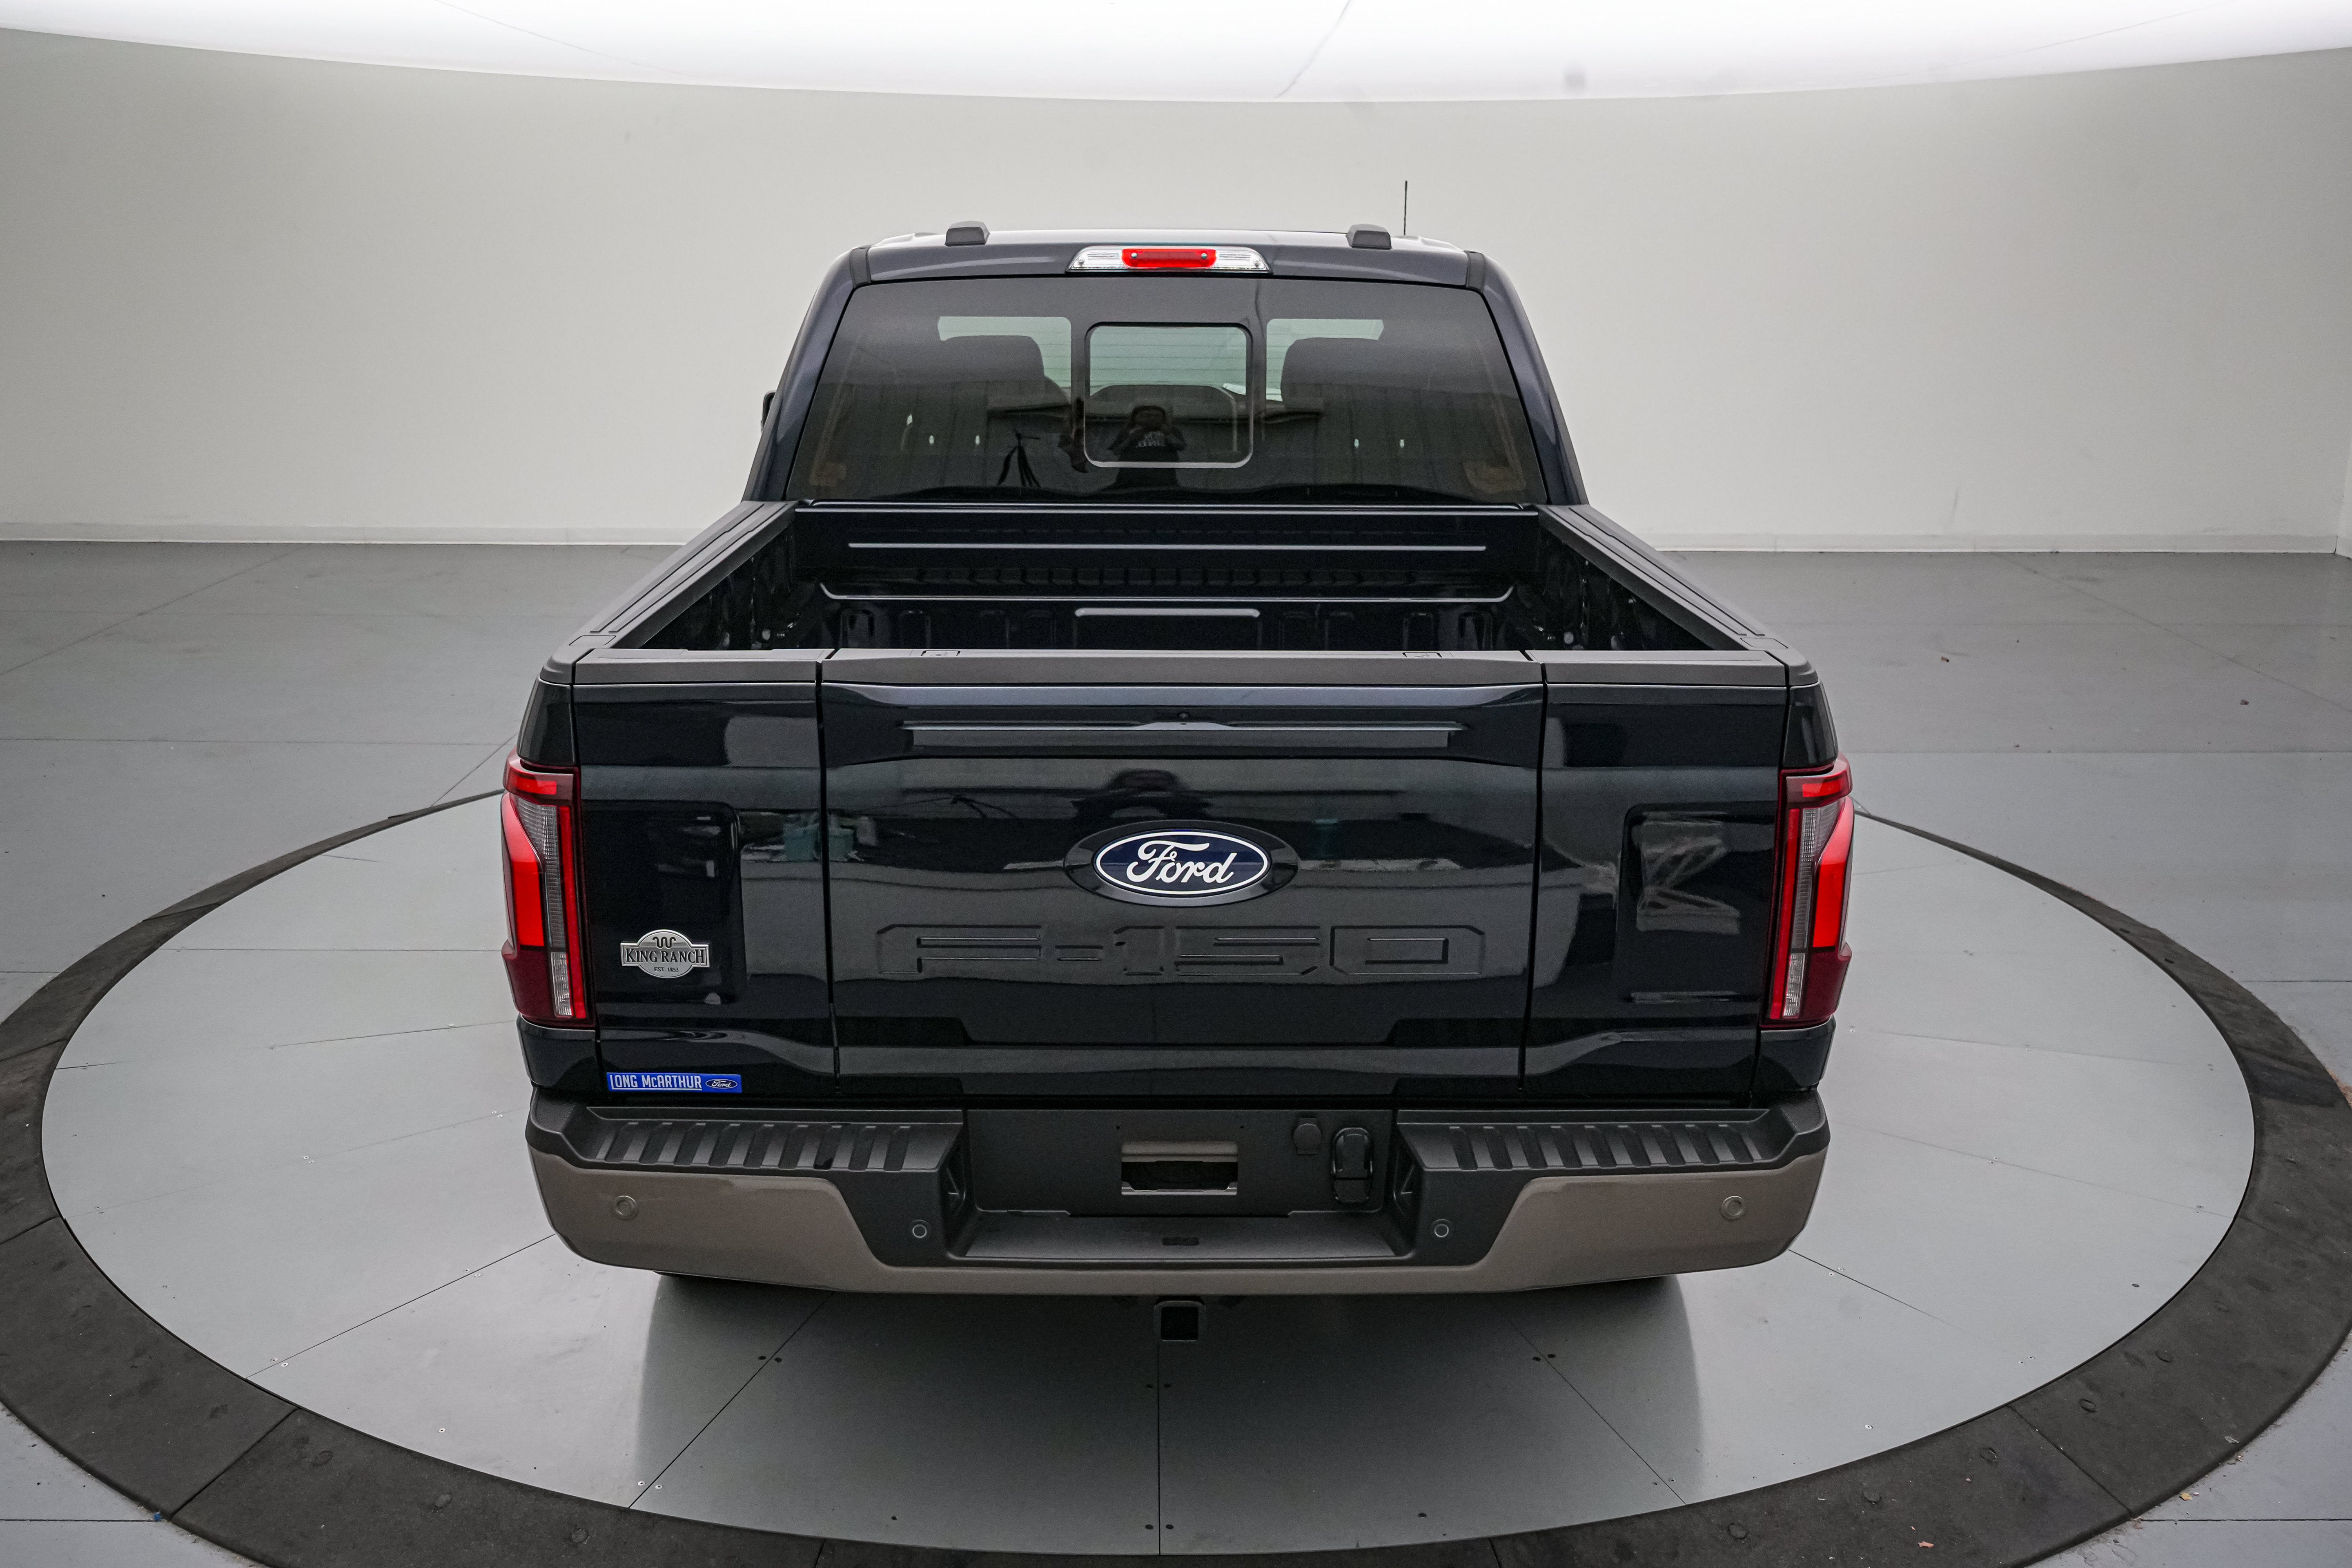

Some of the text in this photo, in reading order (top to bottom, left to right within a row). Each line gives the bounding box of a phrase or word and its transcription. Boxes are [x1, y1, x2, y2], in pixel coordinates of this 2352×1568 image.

[1126, 840, 1238, 883] Ford
[625, 948, 705, 964] KING RANCH
[610, 1074, 638, 1089] LONG
[712, 1079, 731, 1087] Ford
